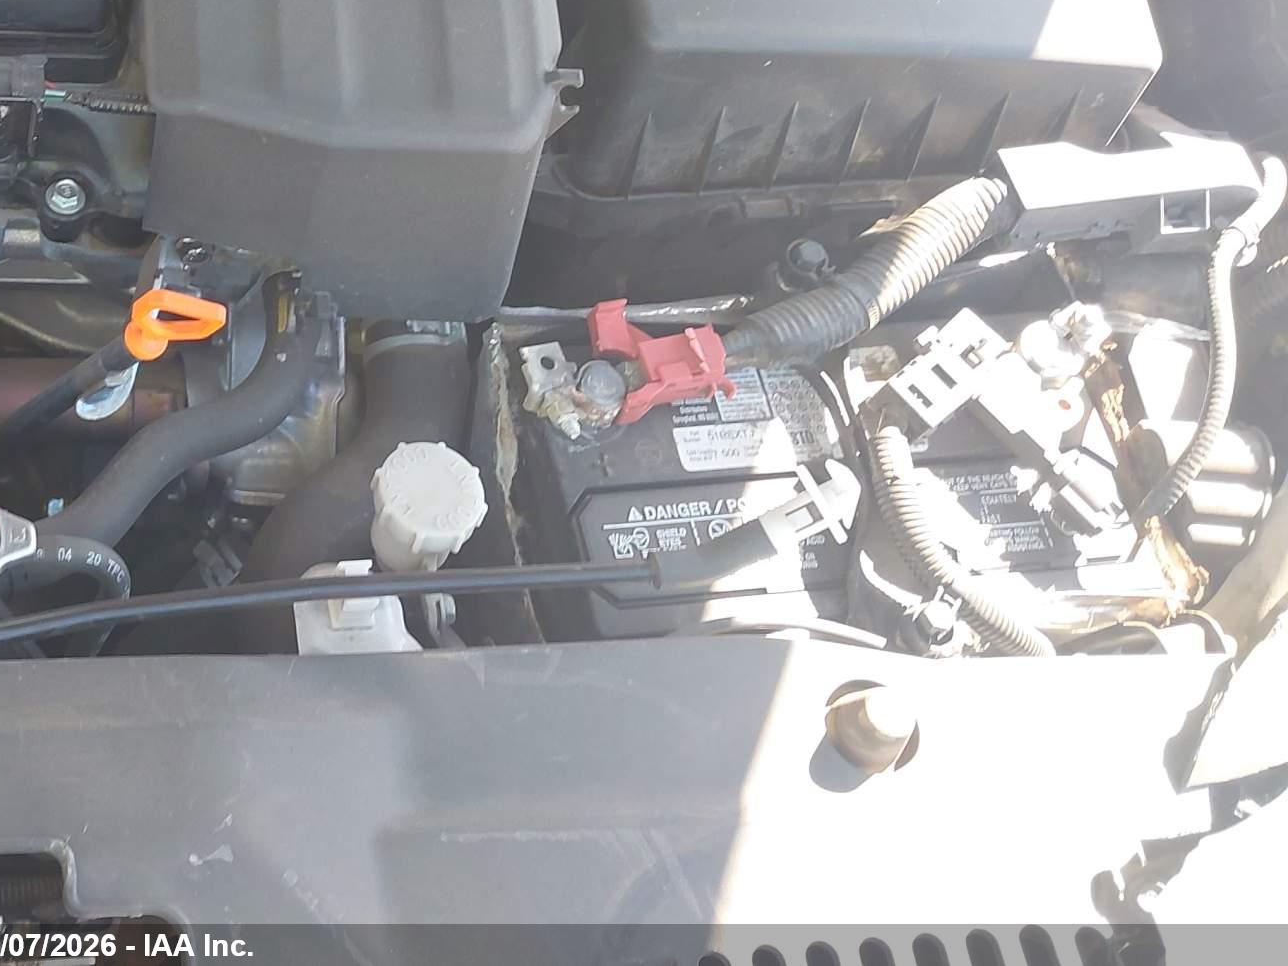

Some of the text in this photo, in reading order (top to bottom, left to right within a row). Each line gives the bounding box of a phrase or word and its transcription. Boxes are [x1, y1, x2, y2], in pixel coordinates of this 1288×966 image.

[644, 500, 712, 518] DANGER
[58, 547, 72, 562] 04
[86, 551, 101, 566] 20
